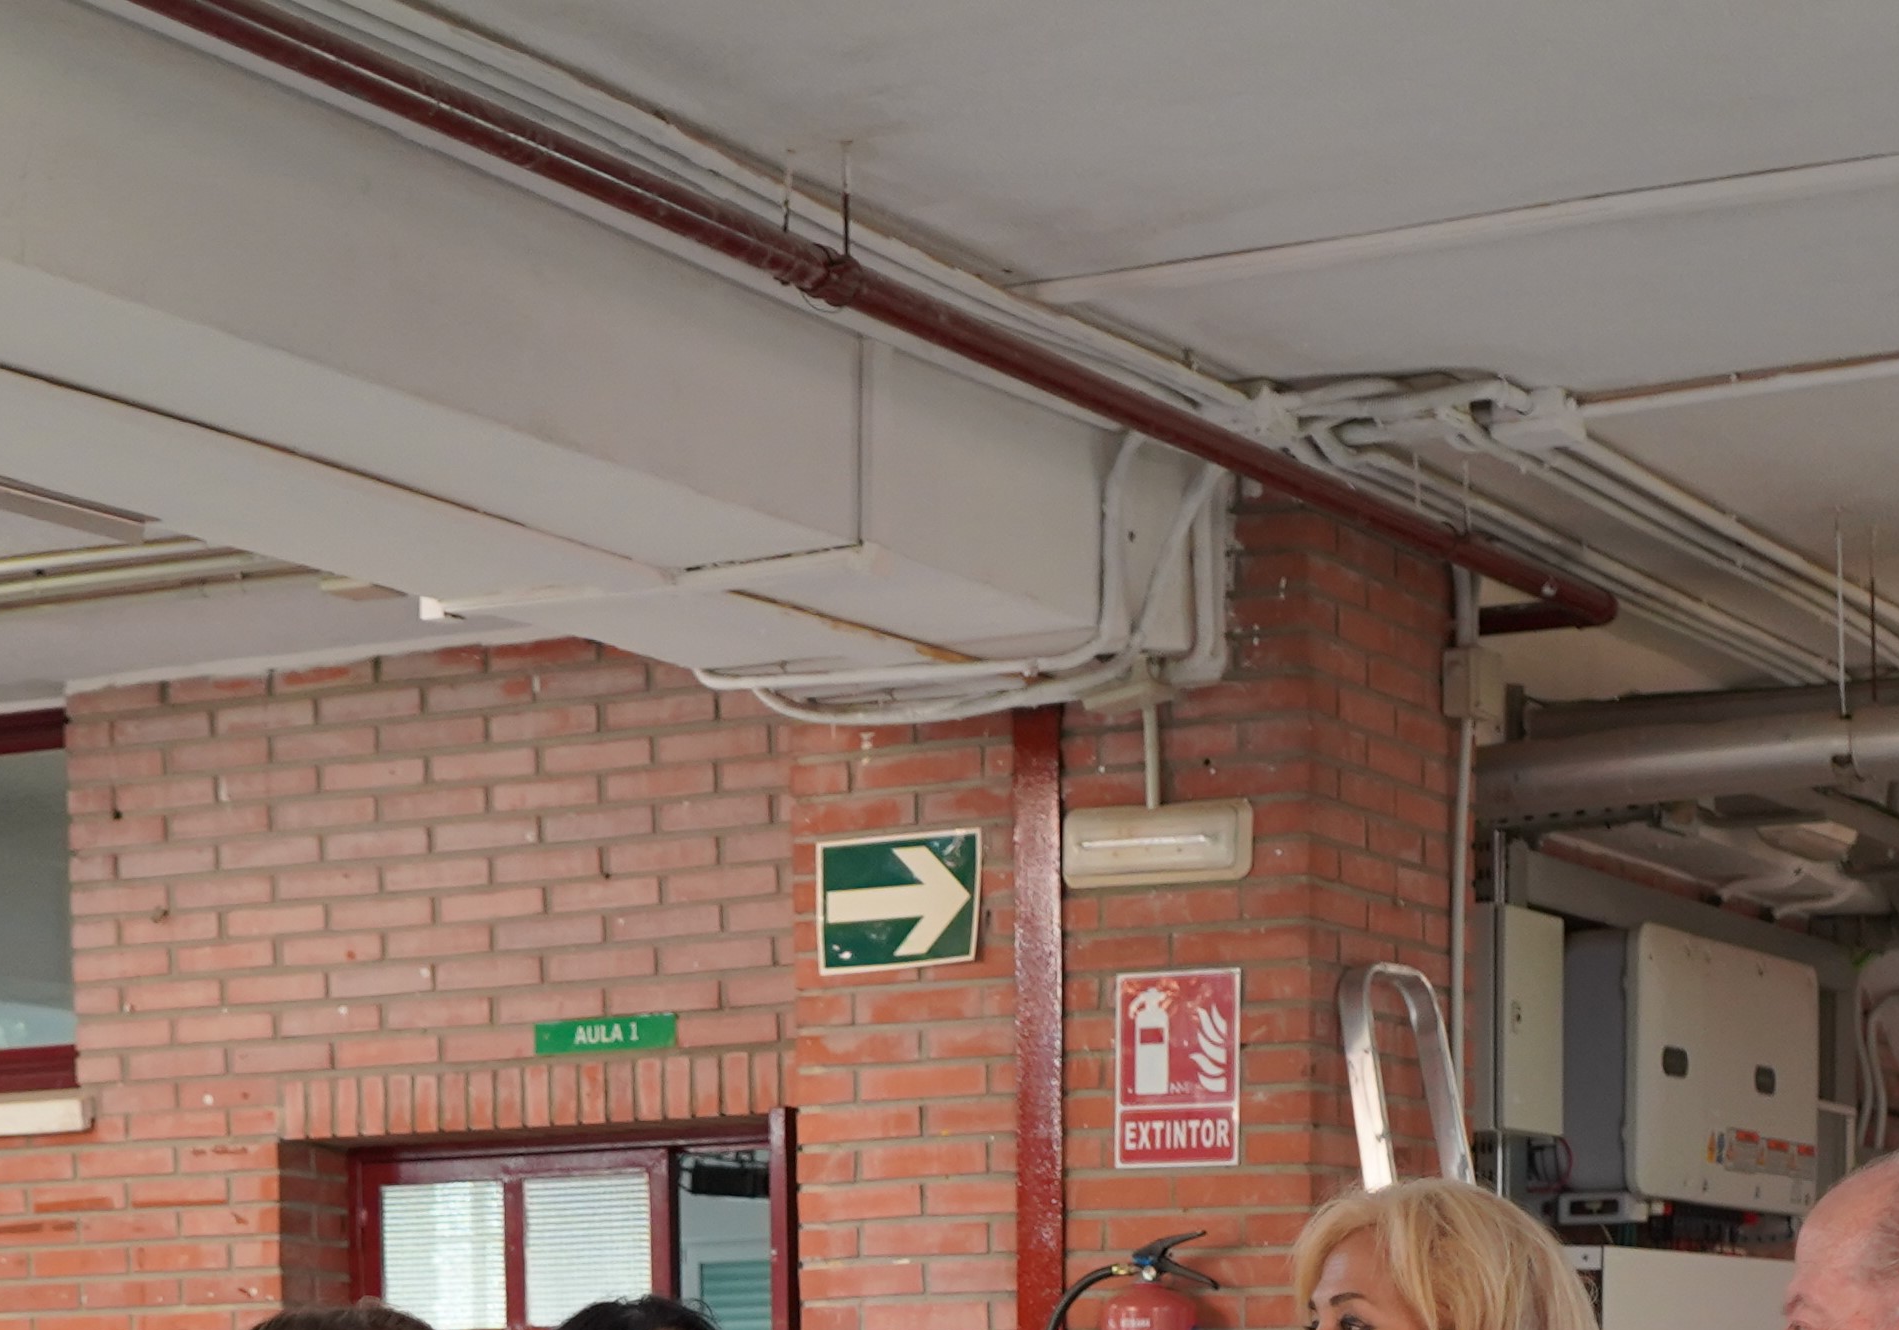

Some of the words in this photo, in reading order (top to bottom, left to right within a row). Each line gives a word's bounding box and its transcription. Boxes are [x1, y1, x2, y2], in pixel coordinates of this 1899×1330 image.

[574, 1023, 624, 1044] AULA
[629, 1021, 639, 1041] 1
[1124, 1119, 1230, 1150] EXTINTOR
